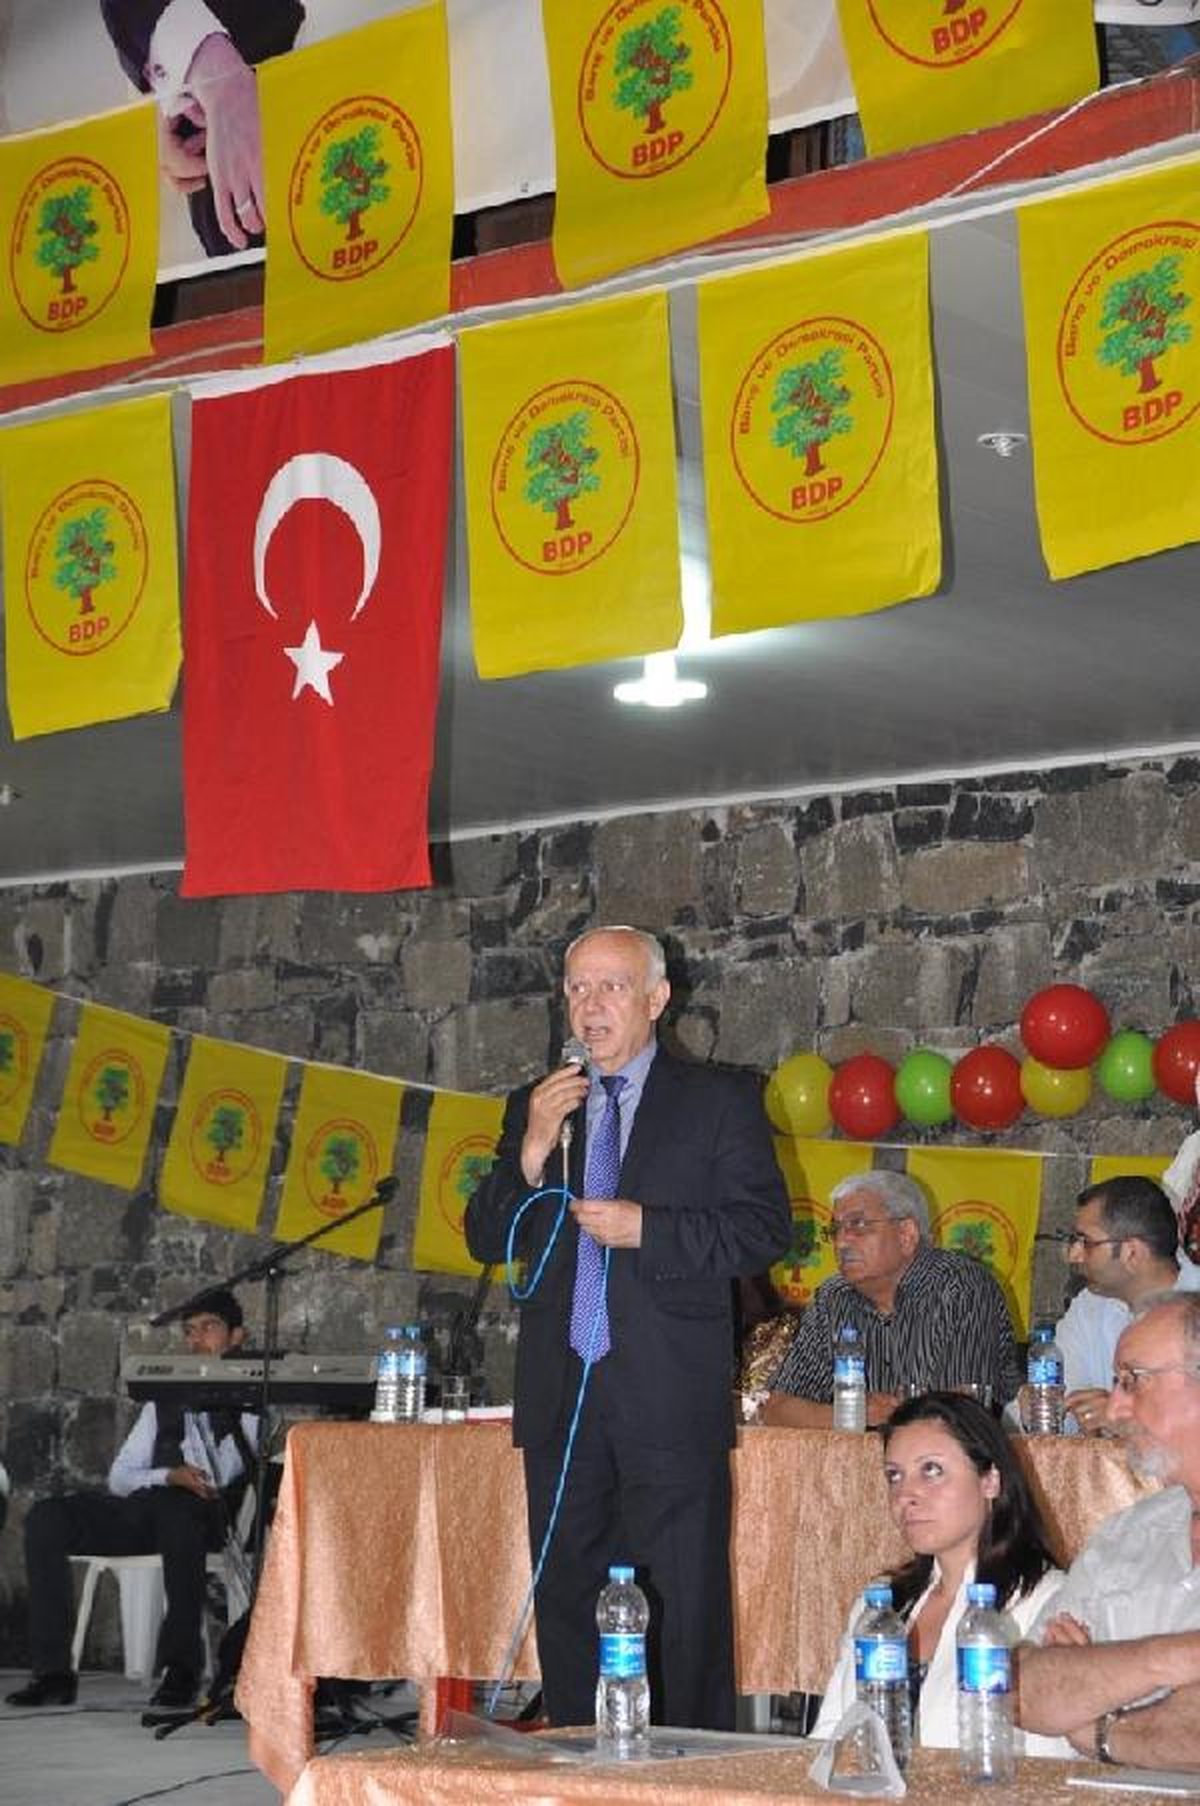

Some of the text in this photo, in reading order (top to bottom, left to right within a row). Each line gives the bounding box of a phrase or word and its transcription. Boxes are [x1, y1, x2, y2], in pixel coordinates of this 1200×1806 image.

[931, 8, 987, 54] BDP
[632, 131, 683, 166] BDP
[332, 239, 379, 269] BDP
[48, 297, 87, 320] BDP
[1122, 391, 1183, 430] BDP
[792, 477, 843, 512] BDP
[542, 532, 593, 562] BDP
[69, 617, 109, 643] BDP
